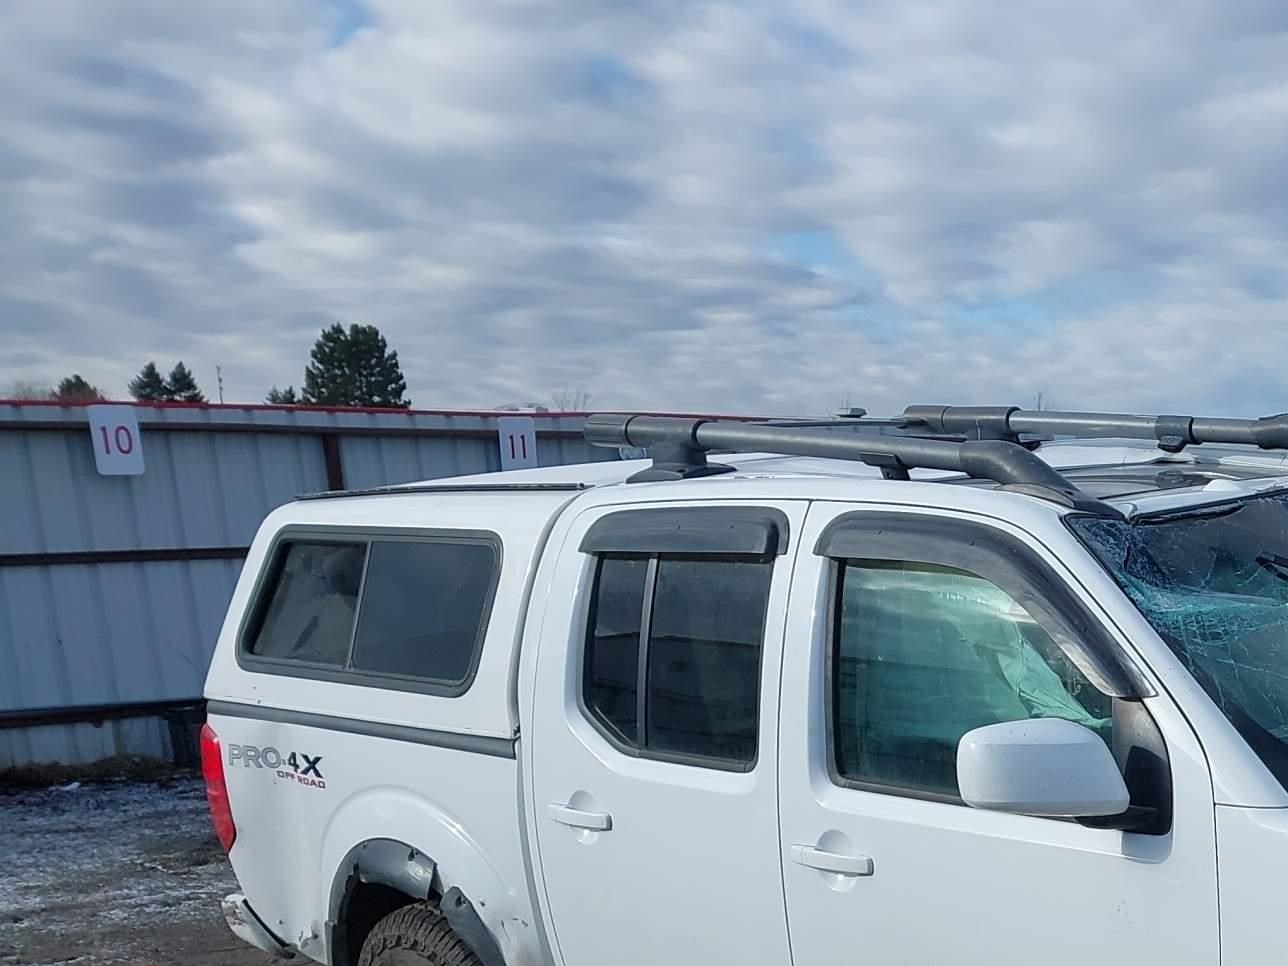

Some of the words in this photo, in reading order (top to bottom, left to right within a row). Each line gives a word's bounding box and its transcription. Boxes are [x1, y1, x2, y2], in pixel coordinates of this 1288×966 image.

[100, 426, 133, 455] 10
[509, 434, 527, 459] 11
[276, 770, 297, 781] OFF
[297, 775, 327, 790] ROAD
